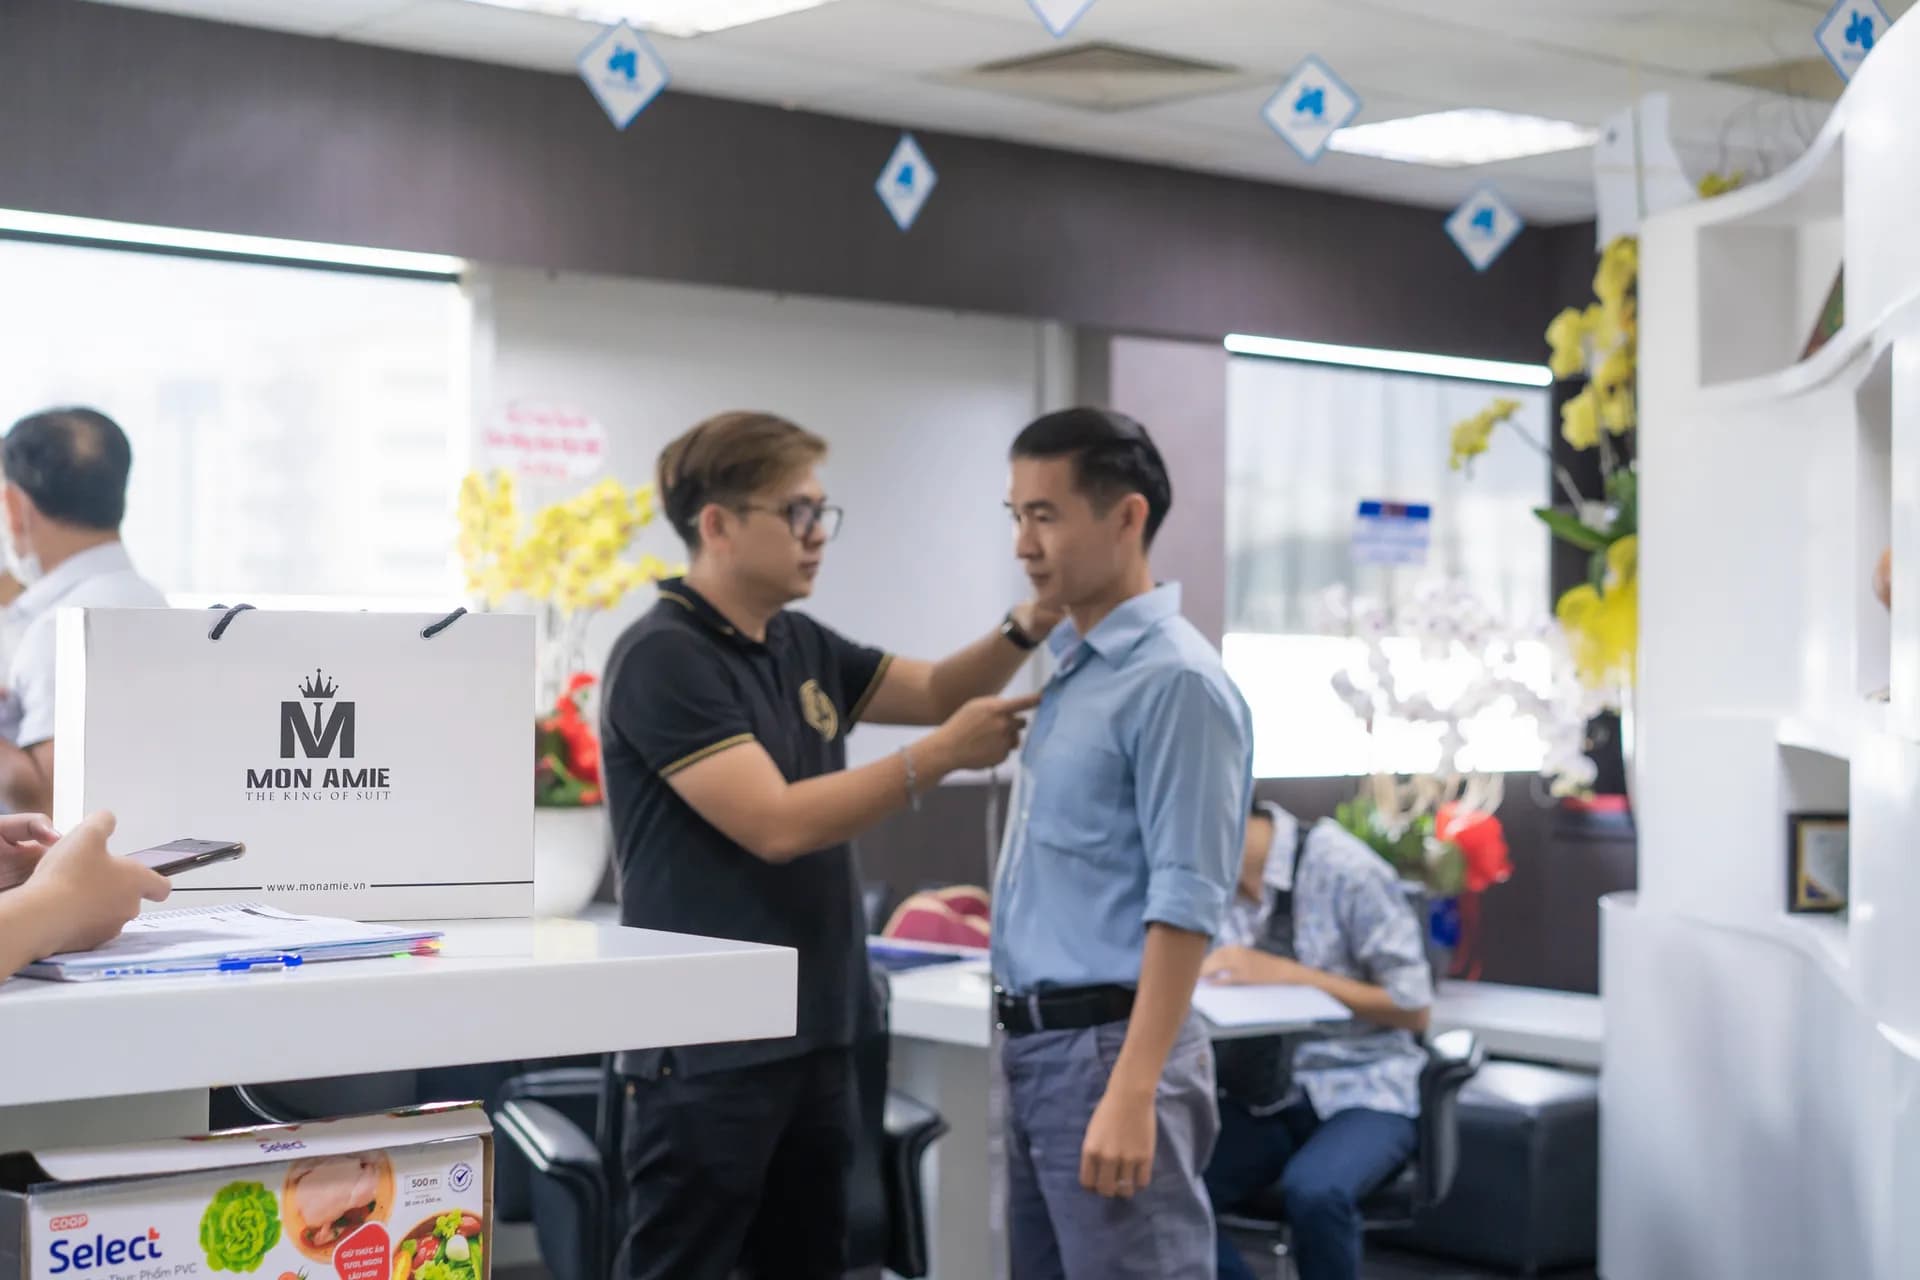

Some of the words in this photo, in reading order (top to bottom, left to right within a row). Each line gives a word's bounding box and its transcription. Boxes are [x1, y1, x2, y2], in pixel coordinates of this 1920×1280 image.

[247, 768, 312, 788] MON
[322, 768, 390, 788] AMIE
[246, 791, 275, 801] THE
[284, 791, 322, 801] KING
[330, 791, 349, 801] OF
[356, 791, 391, 801] SUIT
[266, 881, 366, 892] www.monamie.vn
[411, 1177, 429, 1188] 500
[50, 1214, 88, 1232] COOP
[49, 1226, 162, 1274] Select
[174, 1262, 197, 1274] PVC
